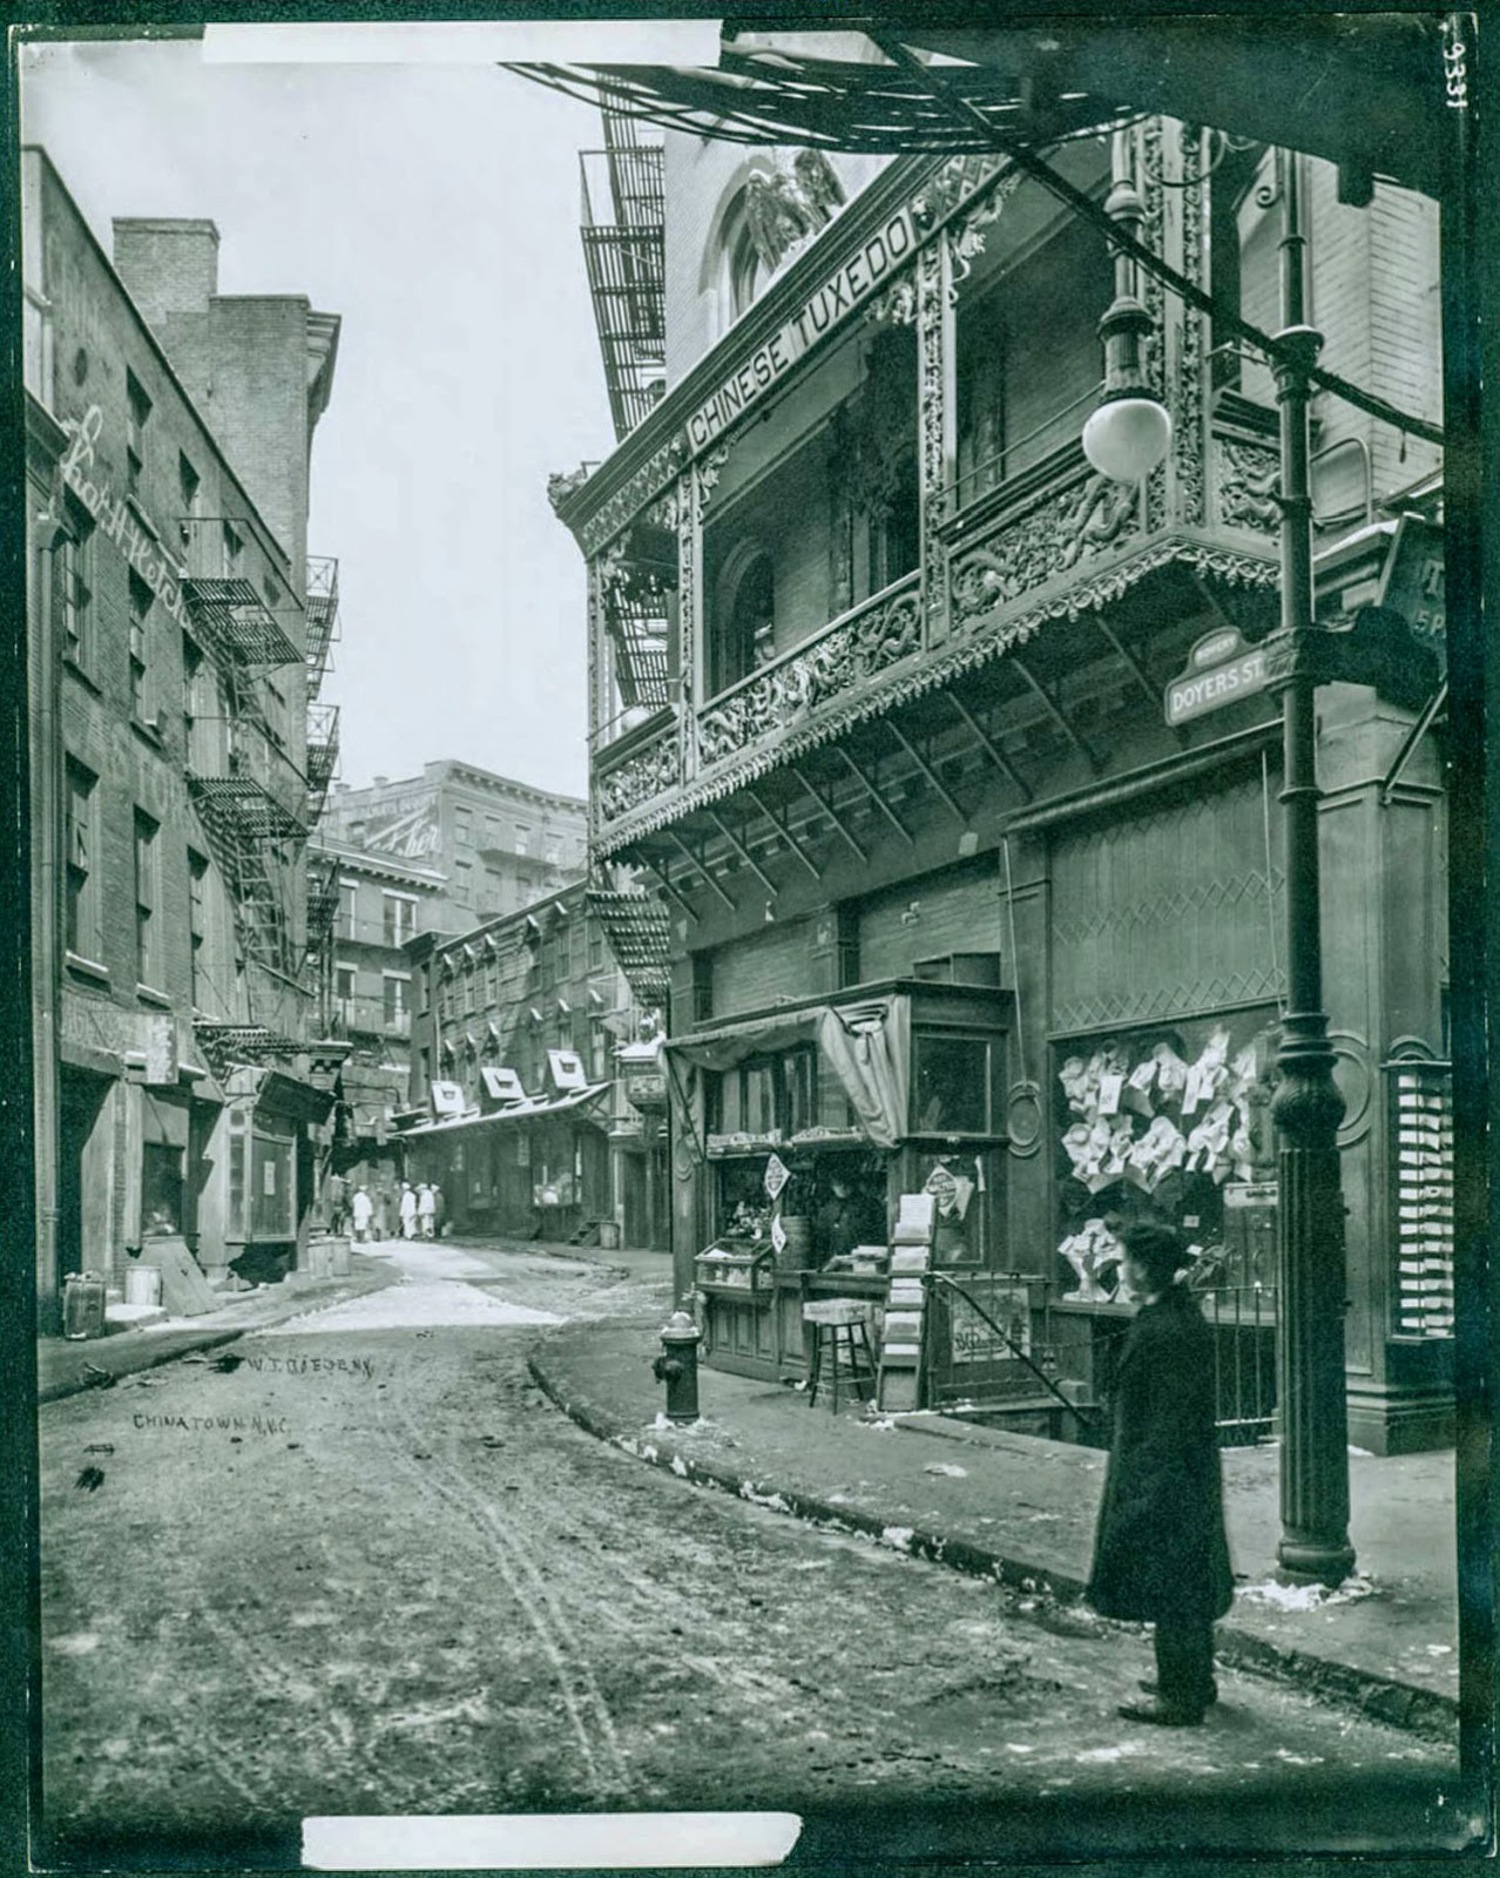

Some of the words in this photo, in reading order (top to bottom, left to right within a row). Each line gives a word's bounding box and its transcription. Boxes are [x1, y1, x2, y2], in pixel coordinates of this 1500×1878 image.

[690, 333, 789, 445] CHINESE
[792, 215, 909, 347] TUXEDO
[1173, 667, 1238, 712] DOYERS
